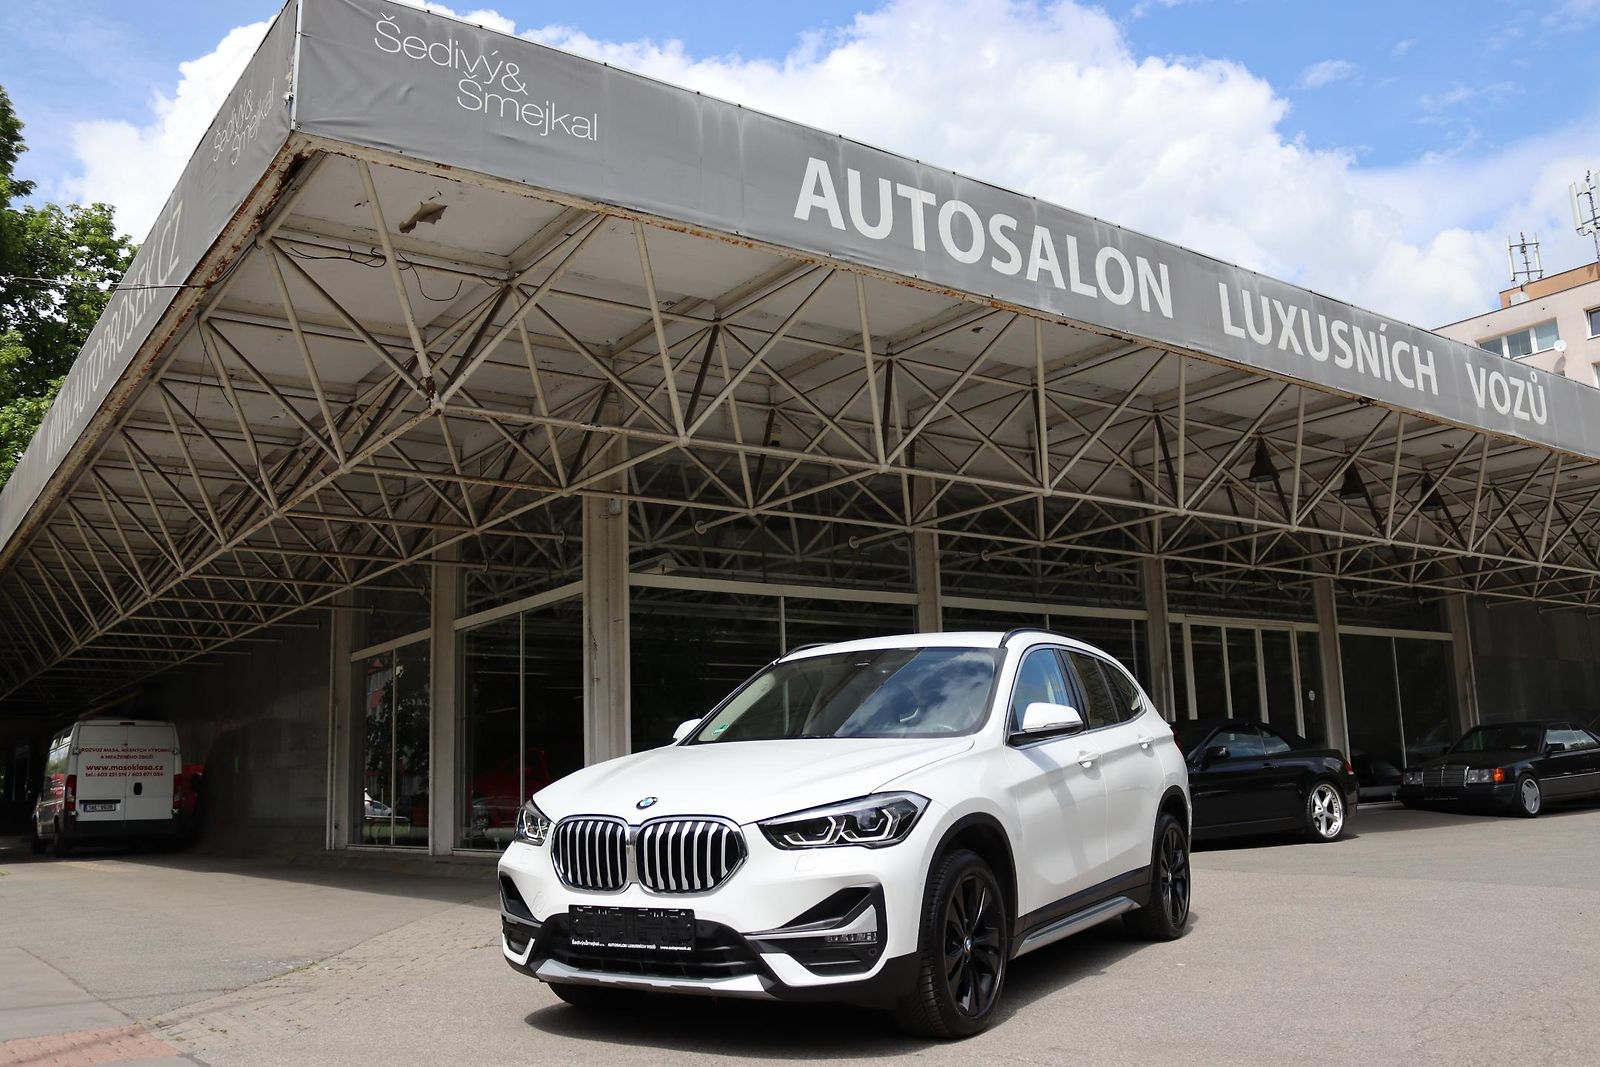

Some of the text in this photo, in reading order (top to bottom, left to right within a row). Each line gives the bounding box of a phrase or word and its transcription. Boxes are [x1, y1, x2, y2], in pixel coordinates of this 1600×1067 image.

[374, 12, 529, 96] Šedivý&
[457, 71, 598, 142] Šmejkal
[793, 156, 1548, 425] AUTOSALON LUXUSNÍCH VOZŮ
